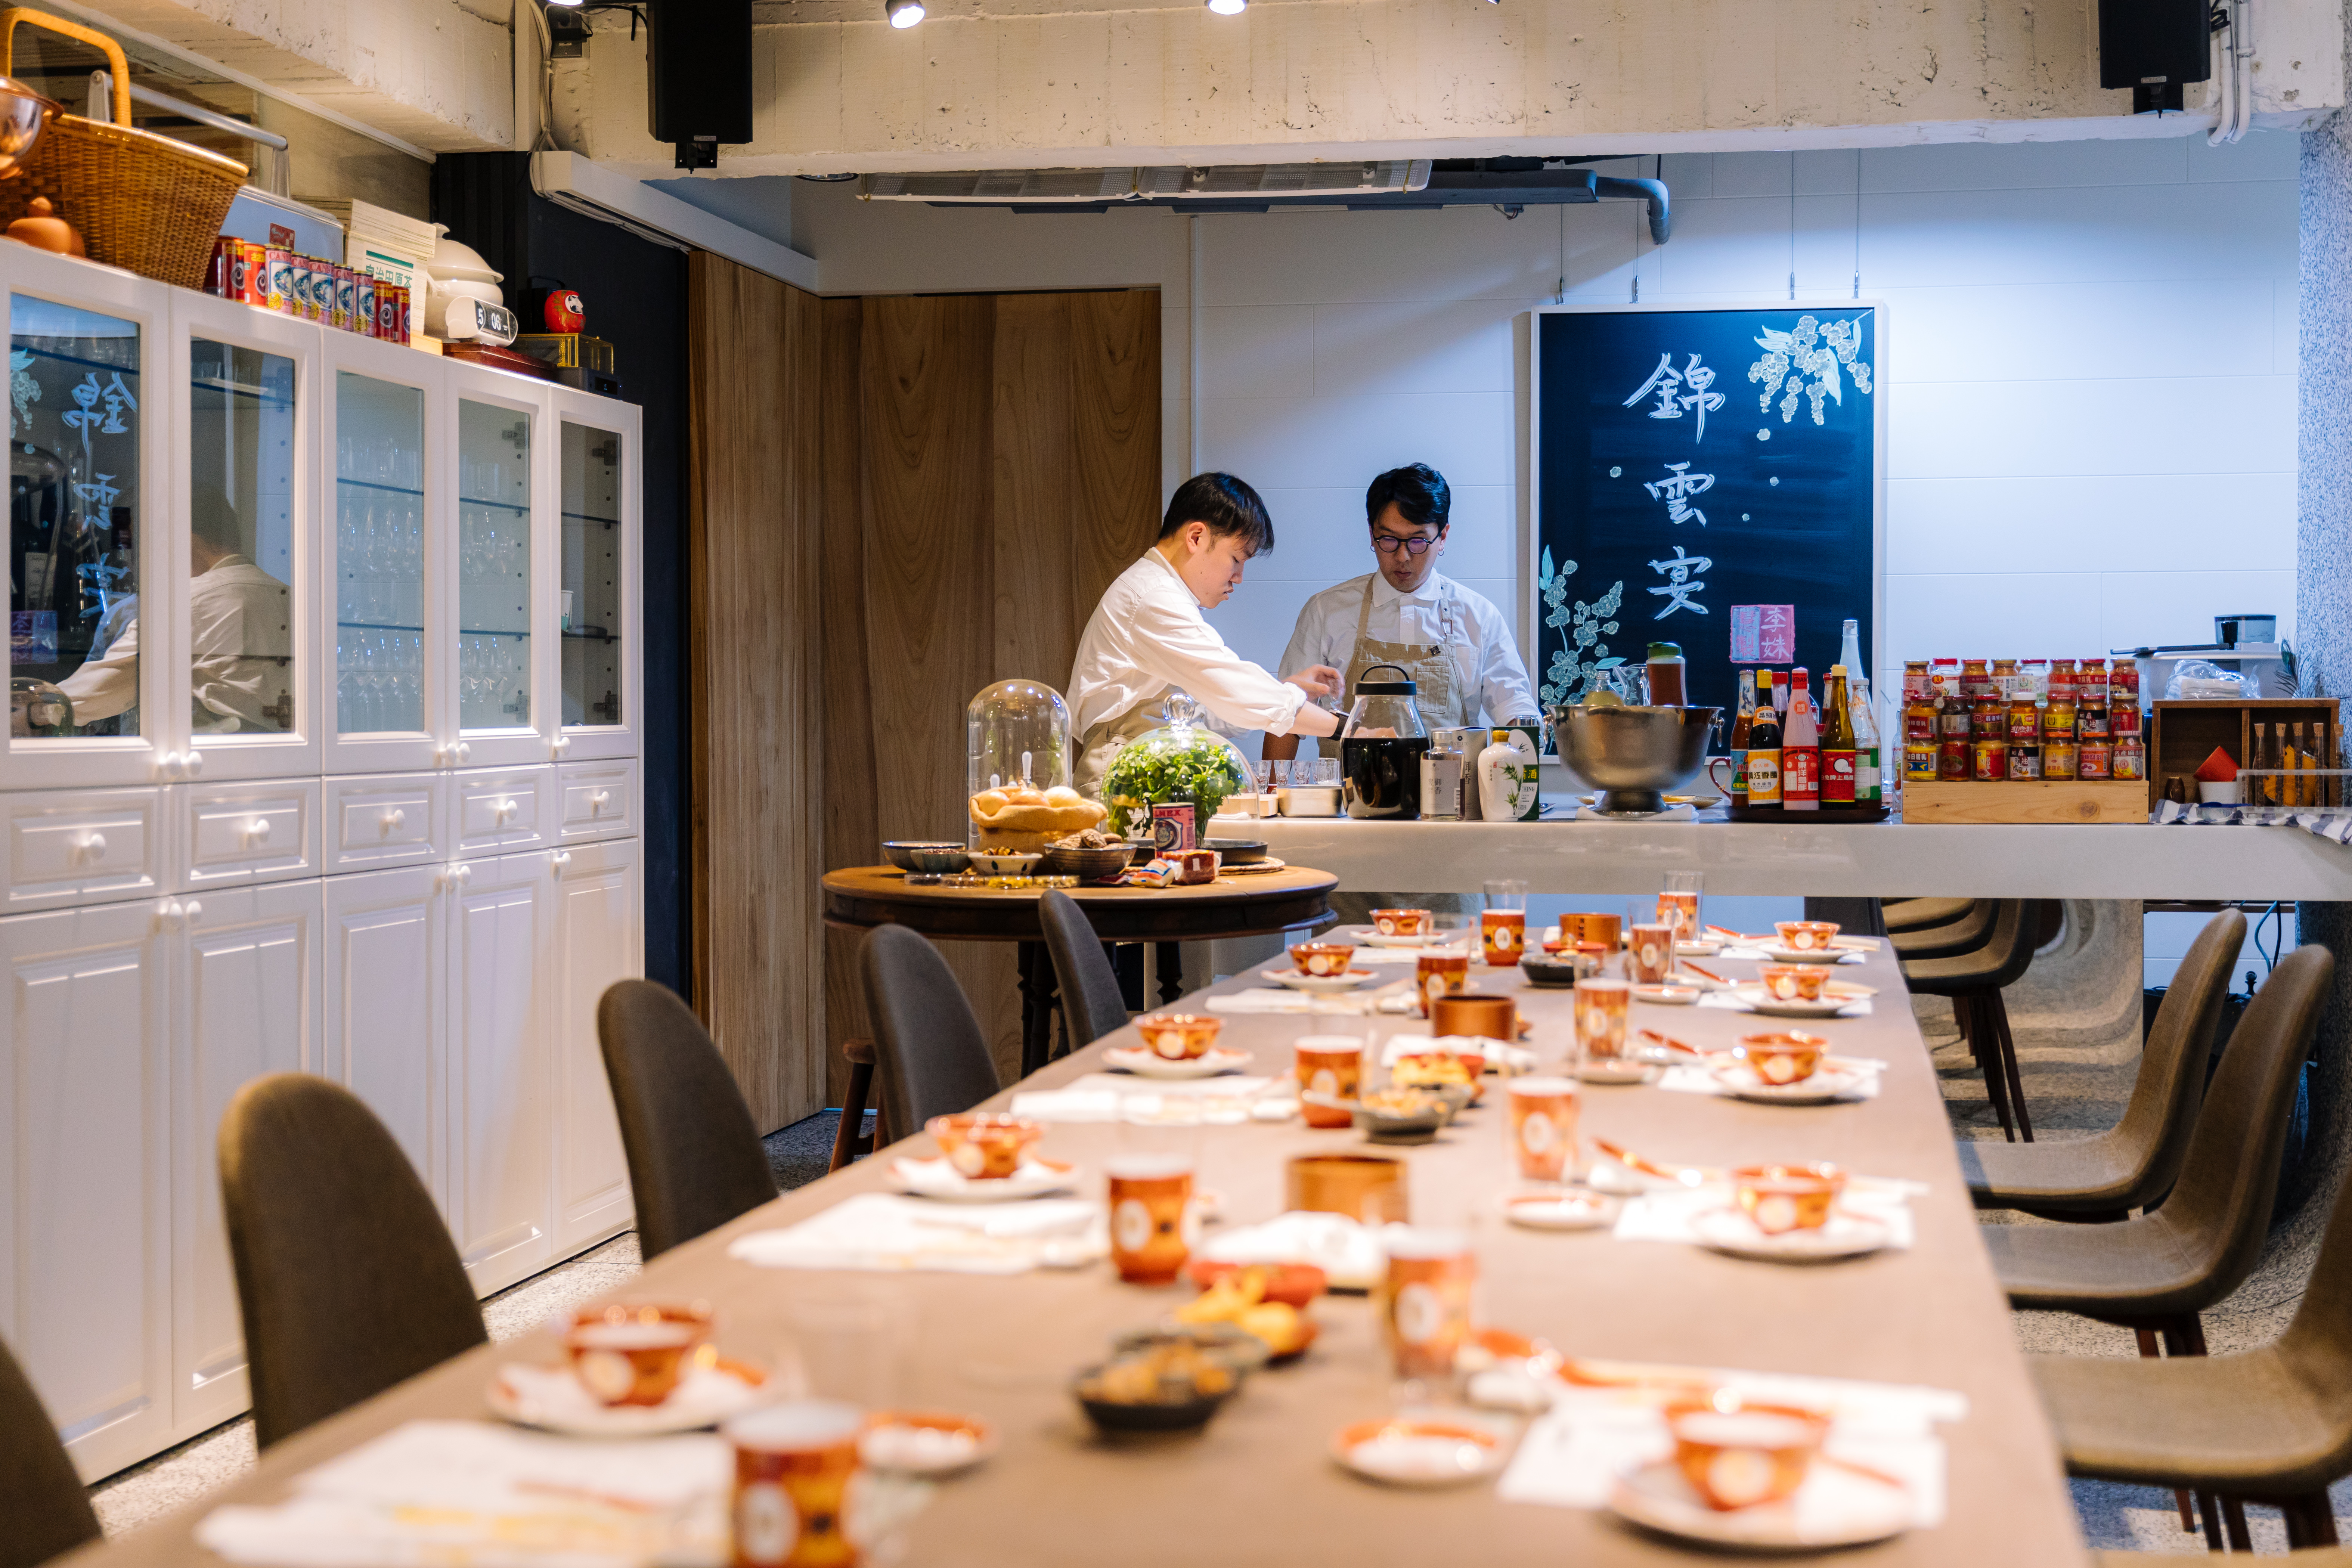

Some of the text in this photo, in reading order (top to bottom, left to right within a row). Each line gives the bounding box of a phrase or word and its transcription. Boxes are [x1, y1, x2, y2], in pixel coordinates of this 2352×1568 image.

[491, 313, 501, 331] 06
[1622, 352, 1725, 620] 錦雲宴
